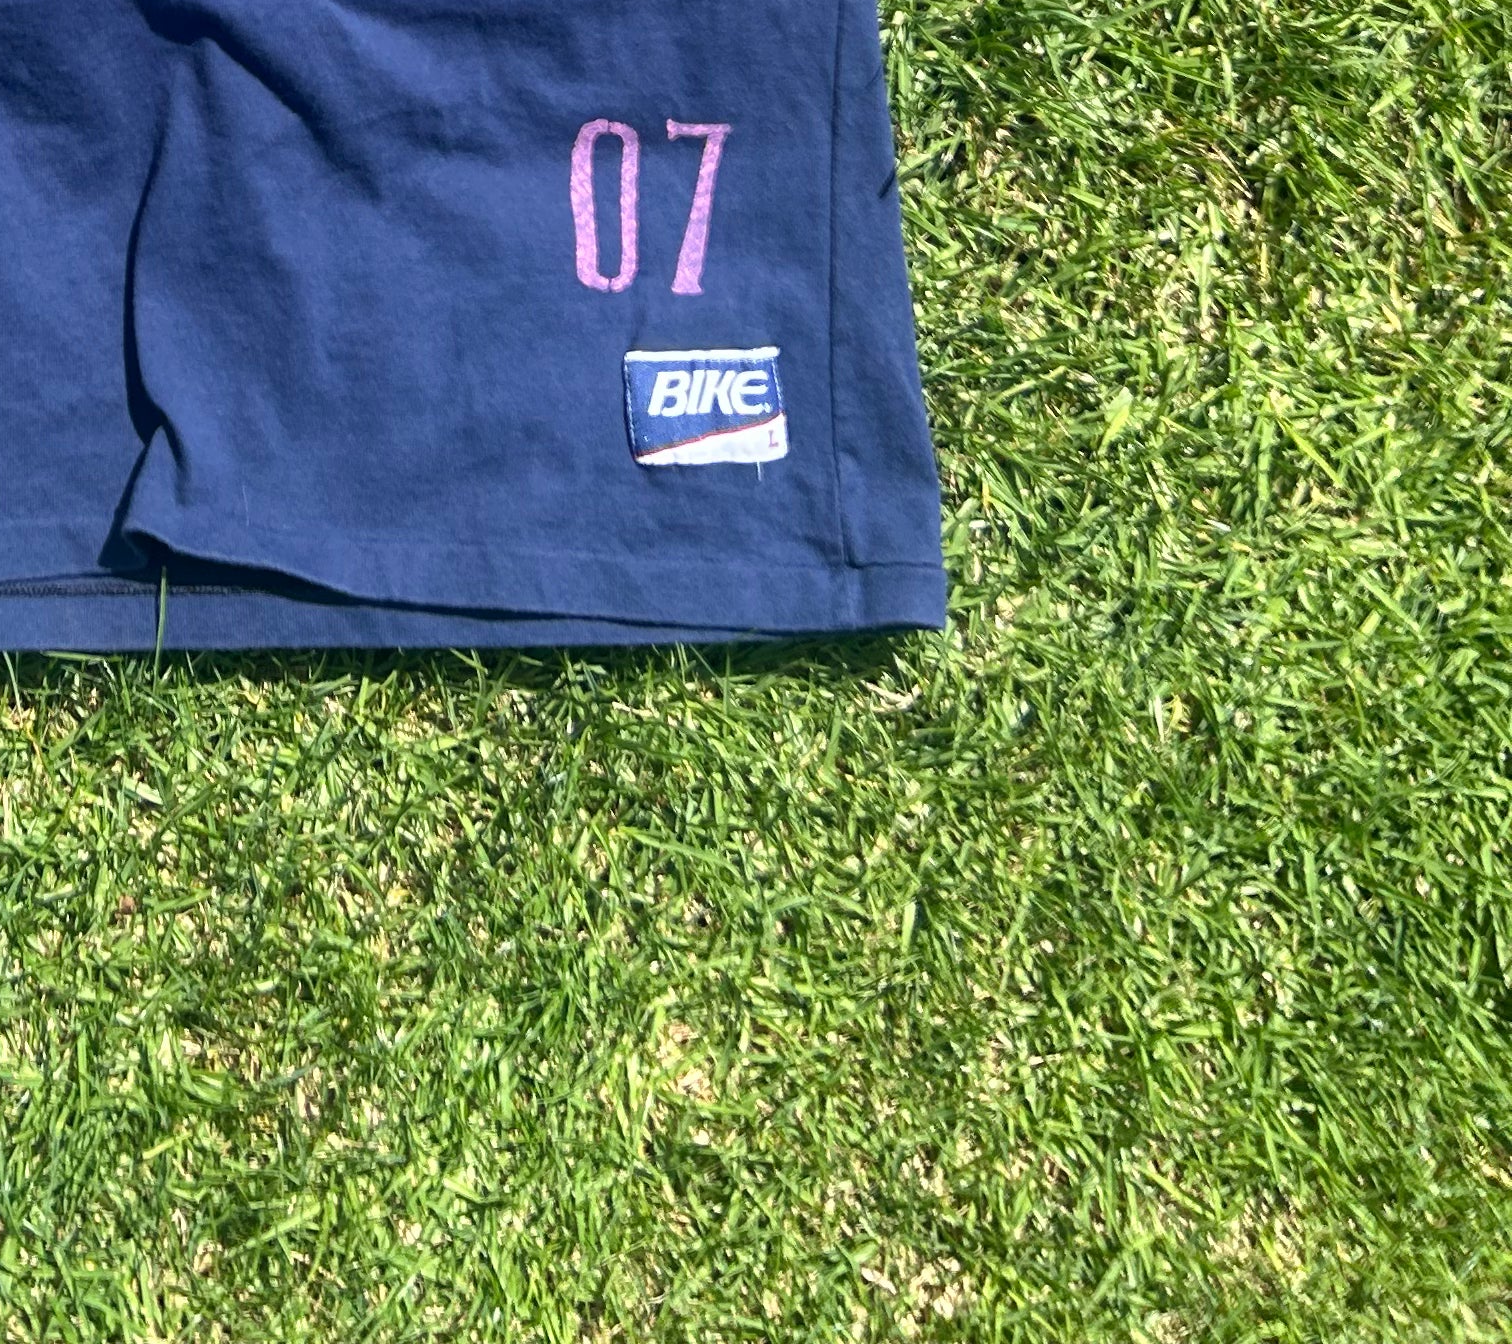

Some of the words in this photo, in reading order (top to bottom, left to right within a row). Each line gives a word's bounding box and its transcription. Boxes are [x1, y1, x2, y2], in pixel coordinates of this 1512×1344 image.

[570, 118, 732, 295] 07
[647, 369, 770, 417] BIKE
[768, 429, 779, 448] L
